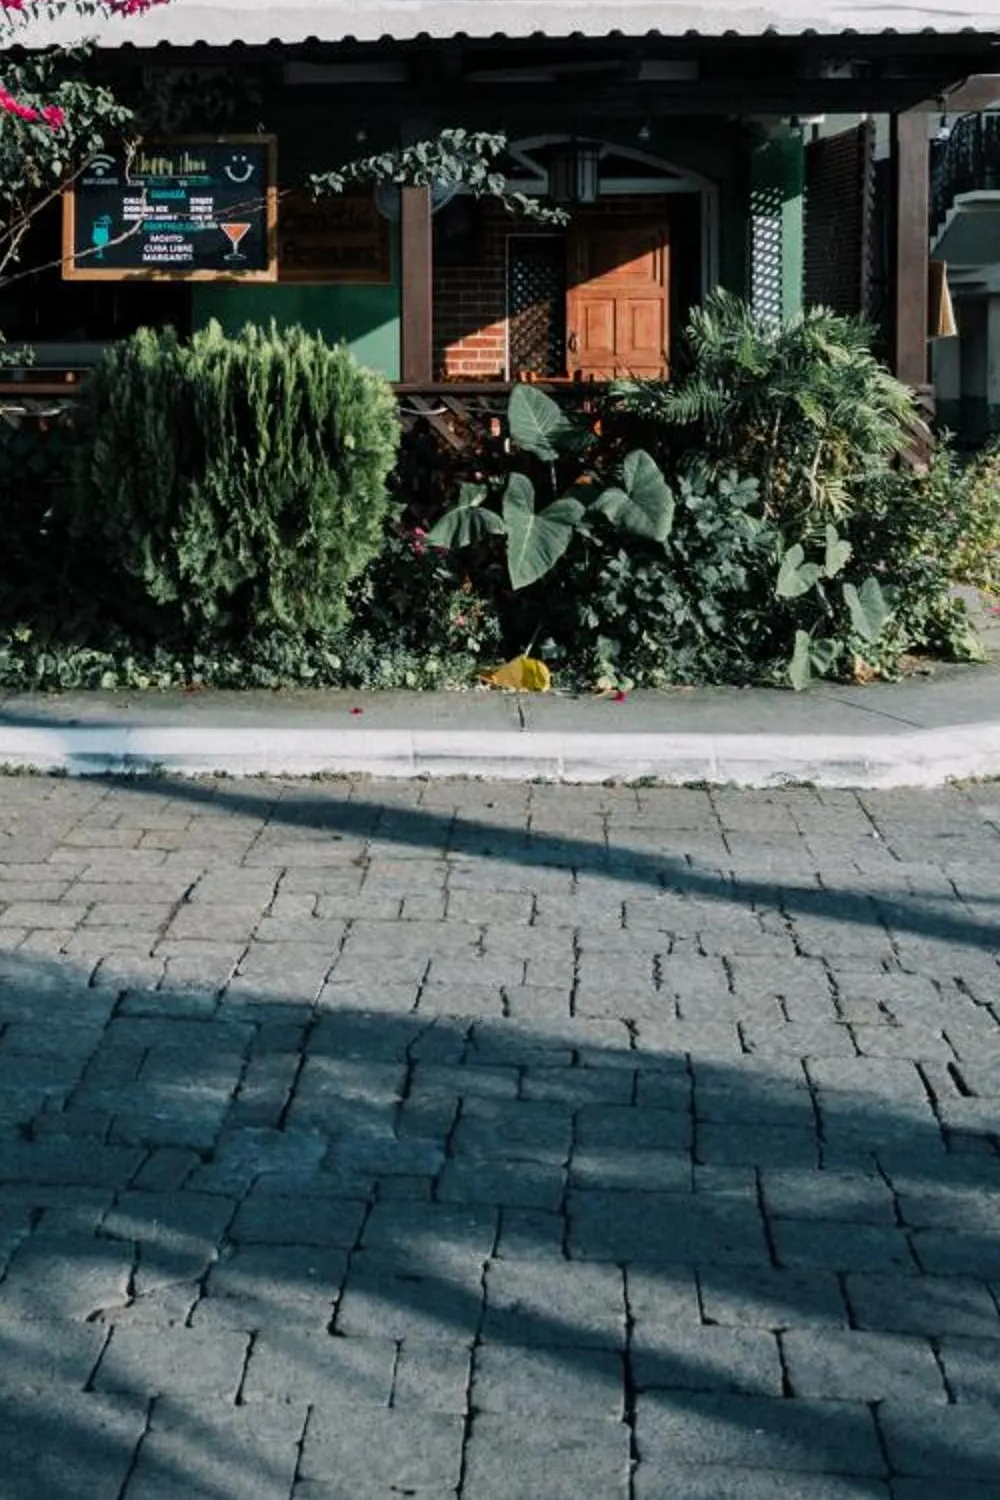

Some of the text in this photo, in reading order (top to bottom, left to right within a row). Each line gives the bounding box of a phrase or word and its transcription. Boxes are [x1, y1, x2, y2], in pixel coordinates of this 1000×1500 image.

[150, 234, 184, 243] MOJITO
[143, 244, 193, 253] CUBA LIBRE
